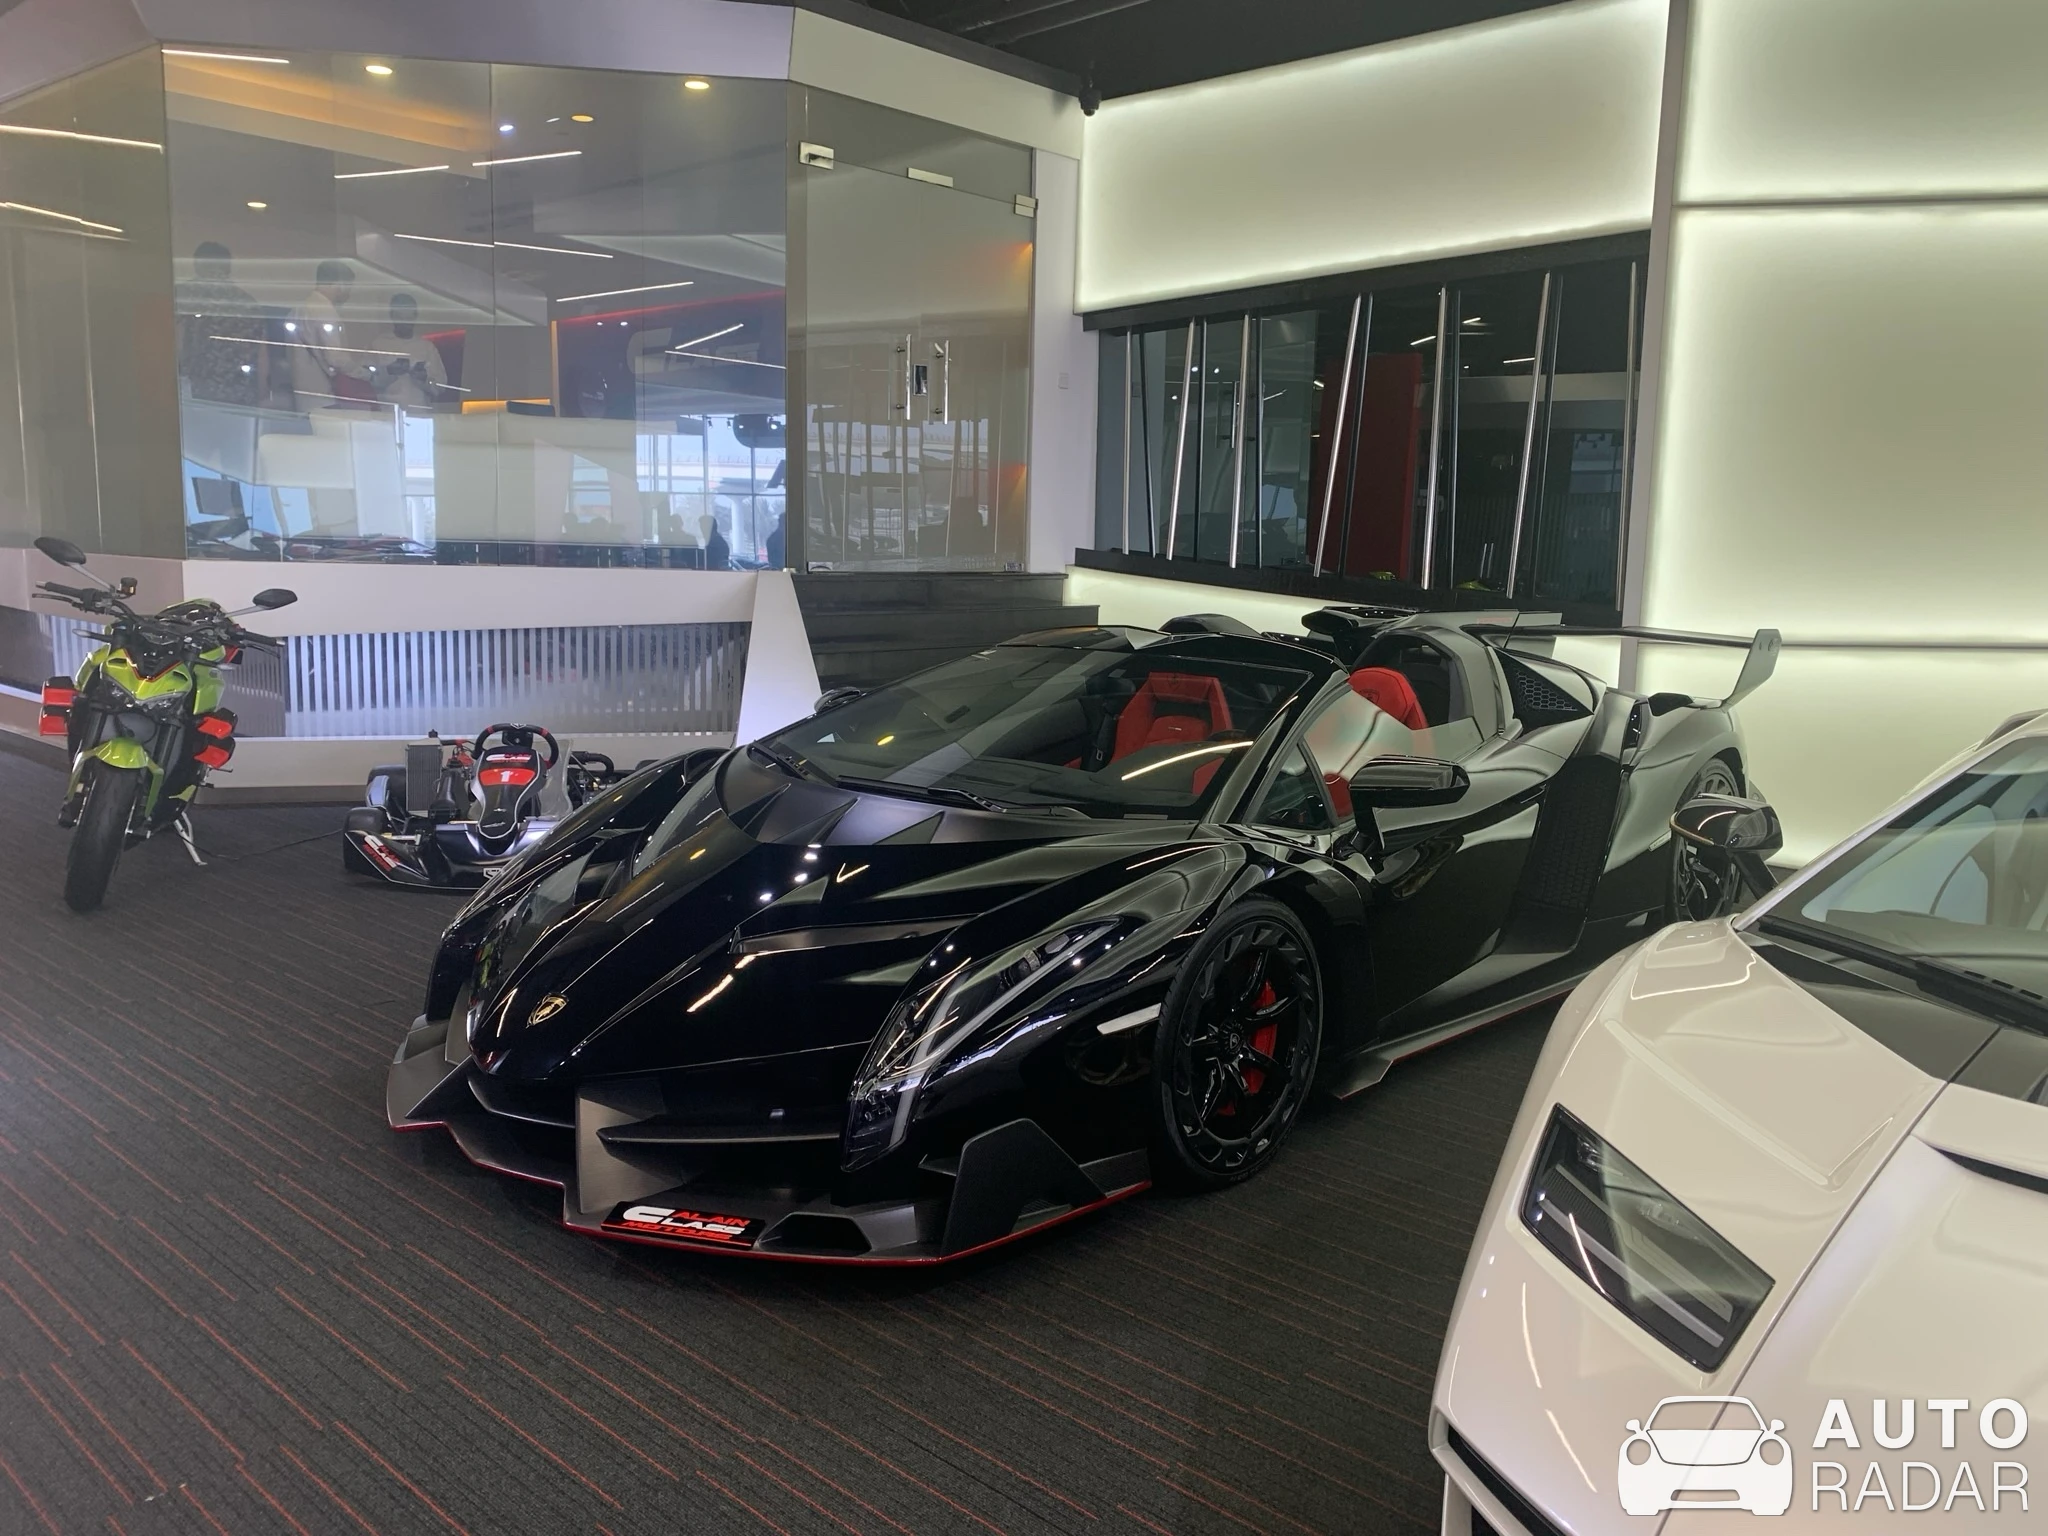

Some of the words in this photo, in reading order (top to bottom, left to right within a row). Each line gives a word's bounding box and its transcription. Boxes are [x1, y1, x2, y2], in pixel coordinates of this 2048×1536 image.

[500, 770, 511, 783] 1
[623, 1206, 745, 1235] CLASS
[672, 1211, 751, 1227] ALAIN
